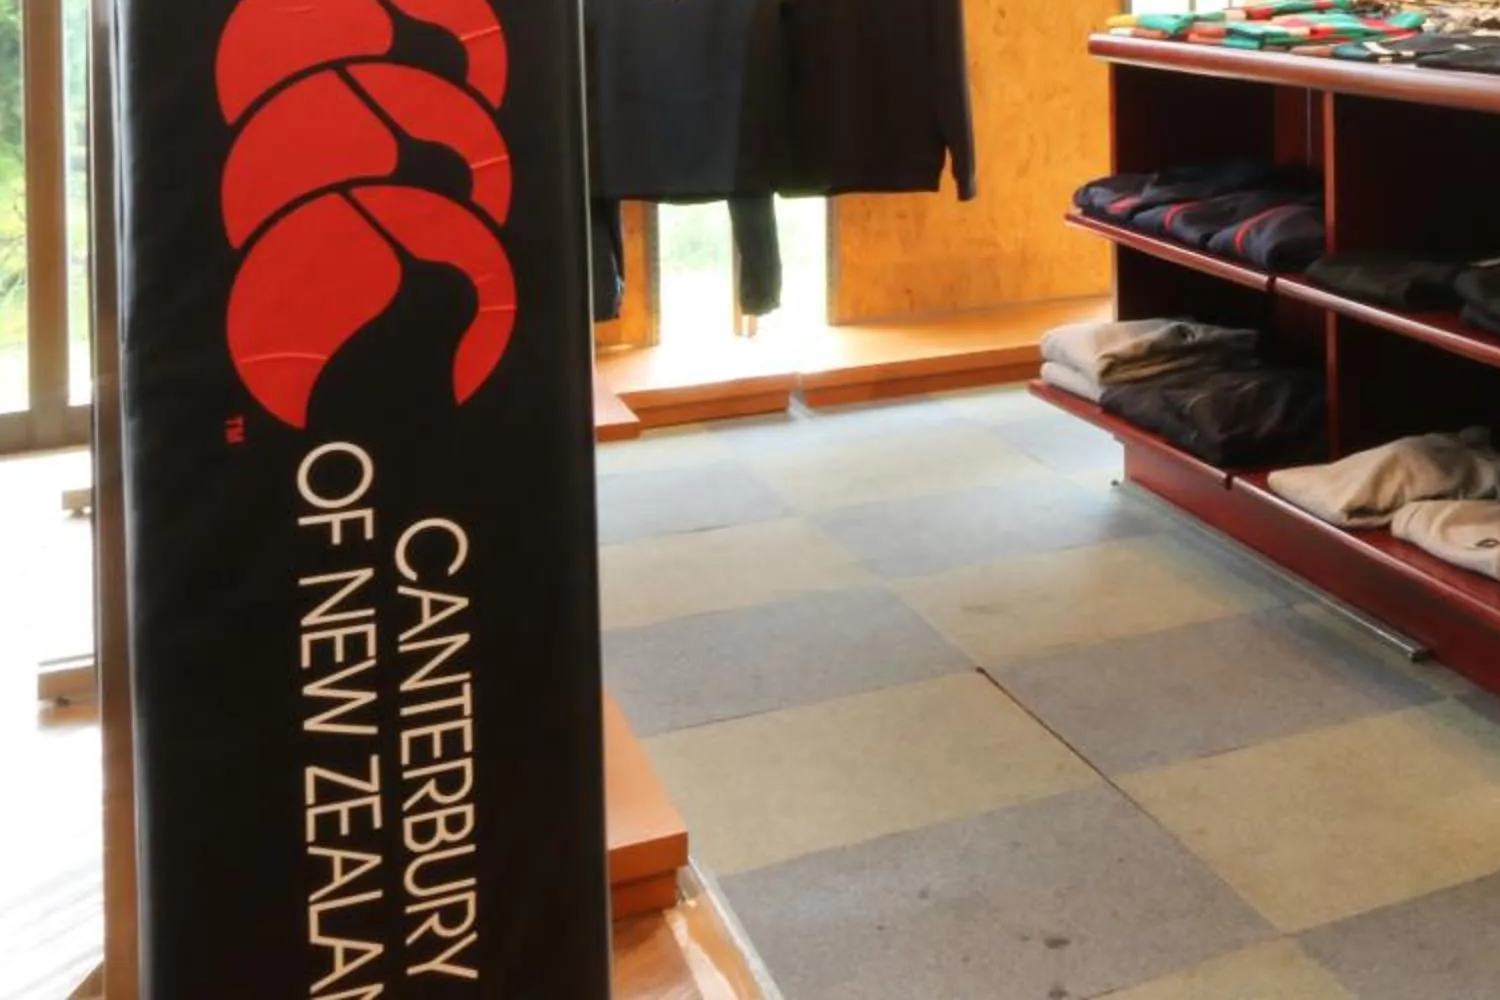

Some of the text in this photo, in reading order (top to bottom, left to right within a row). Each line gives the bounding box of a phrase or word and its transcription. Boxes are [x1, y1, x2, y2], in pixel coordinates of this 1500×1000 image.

[297, 441, 385, 1000] OF NEW ZEALA
[395, 517, 479, 979] CANTERBURY
